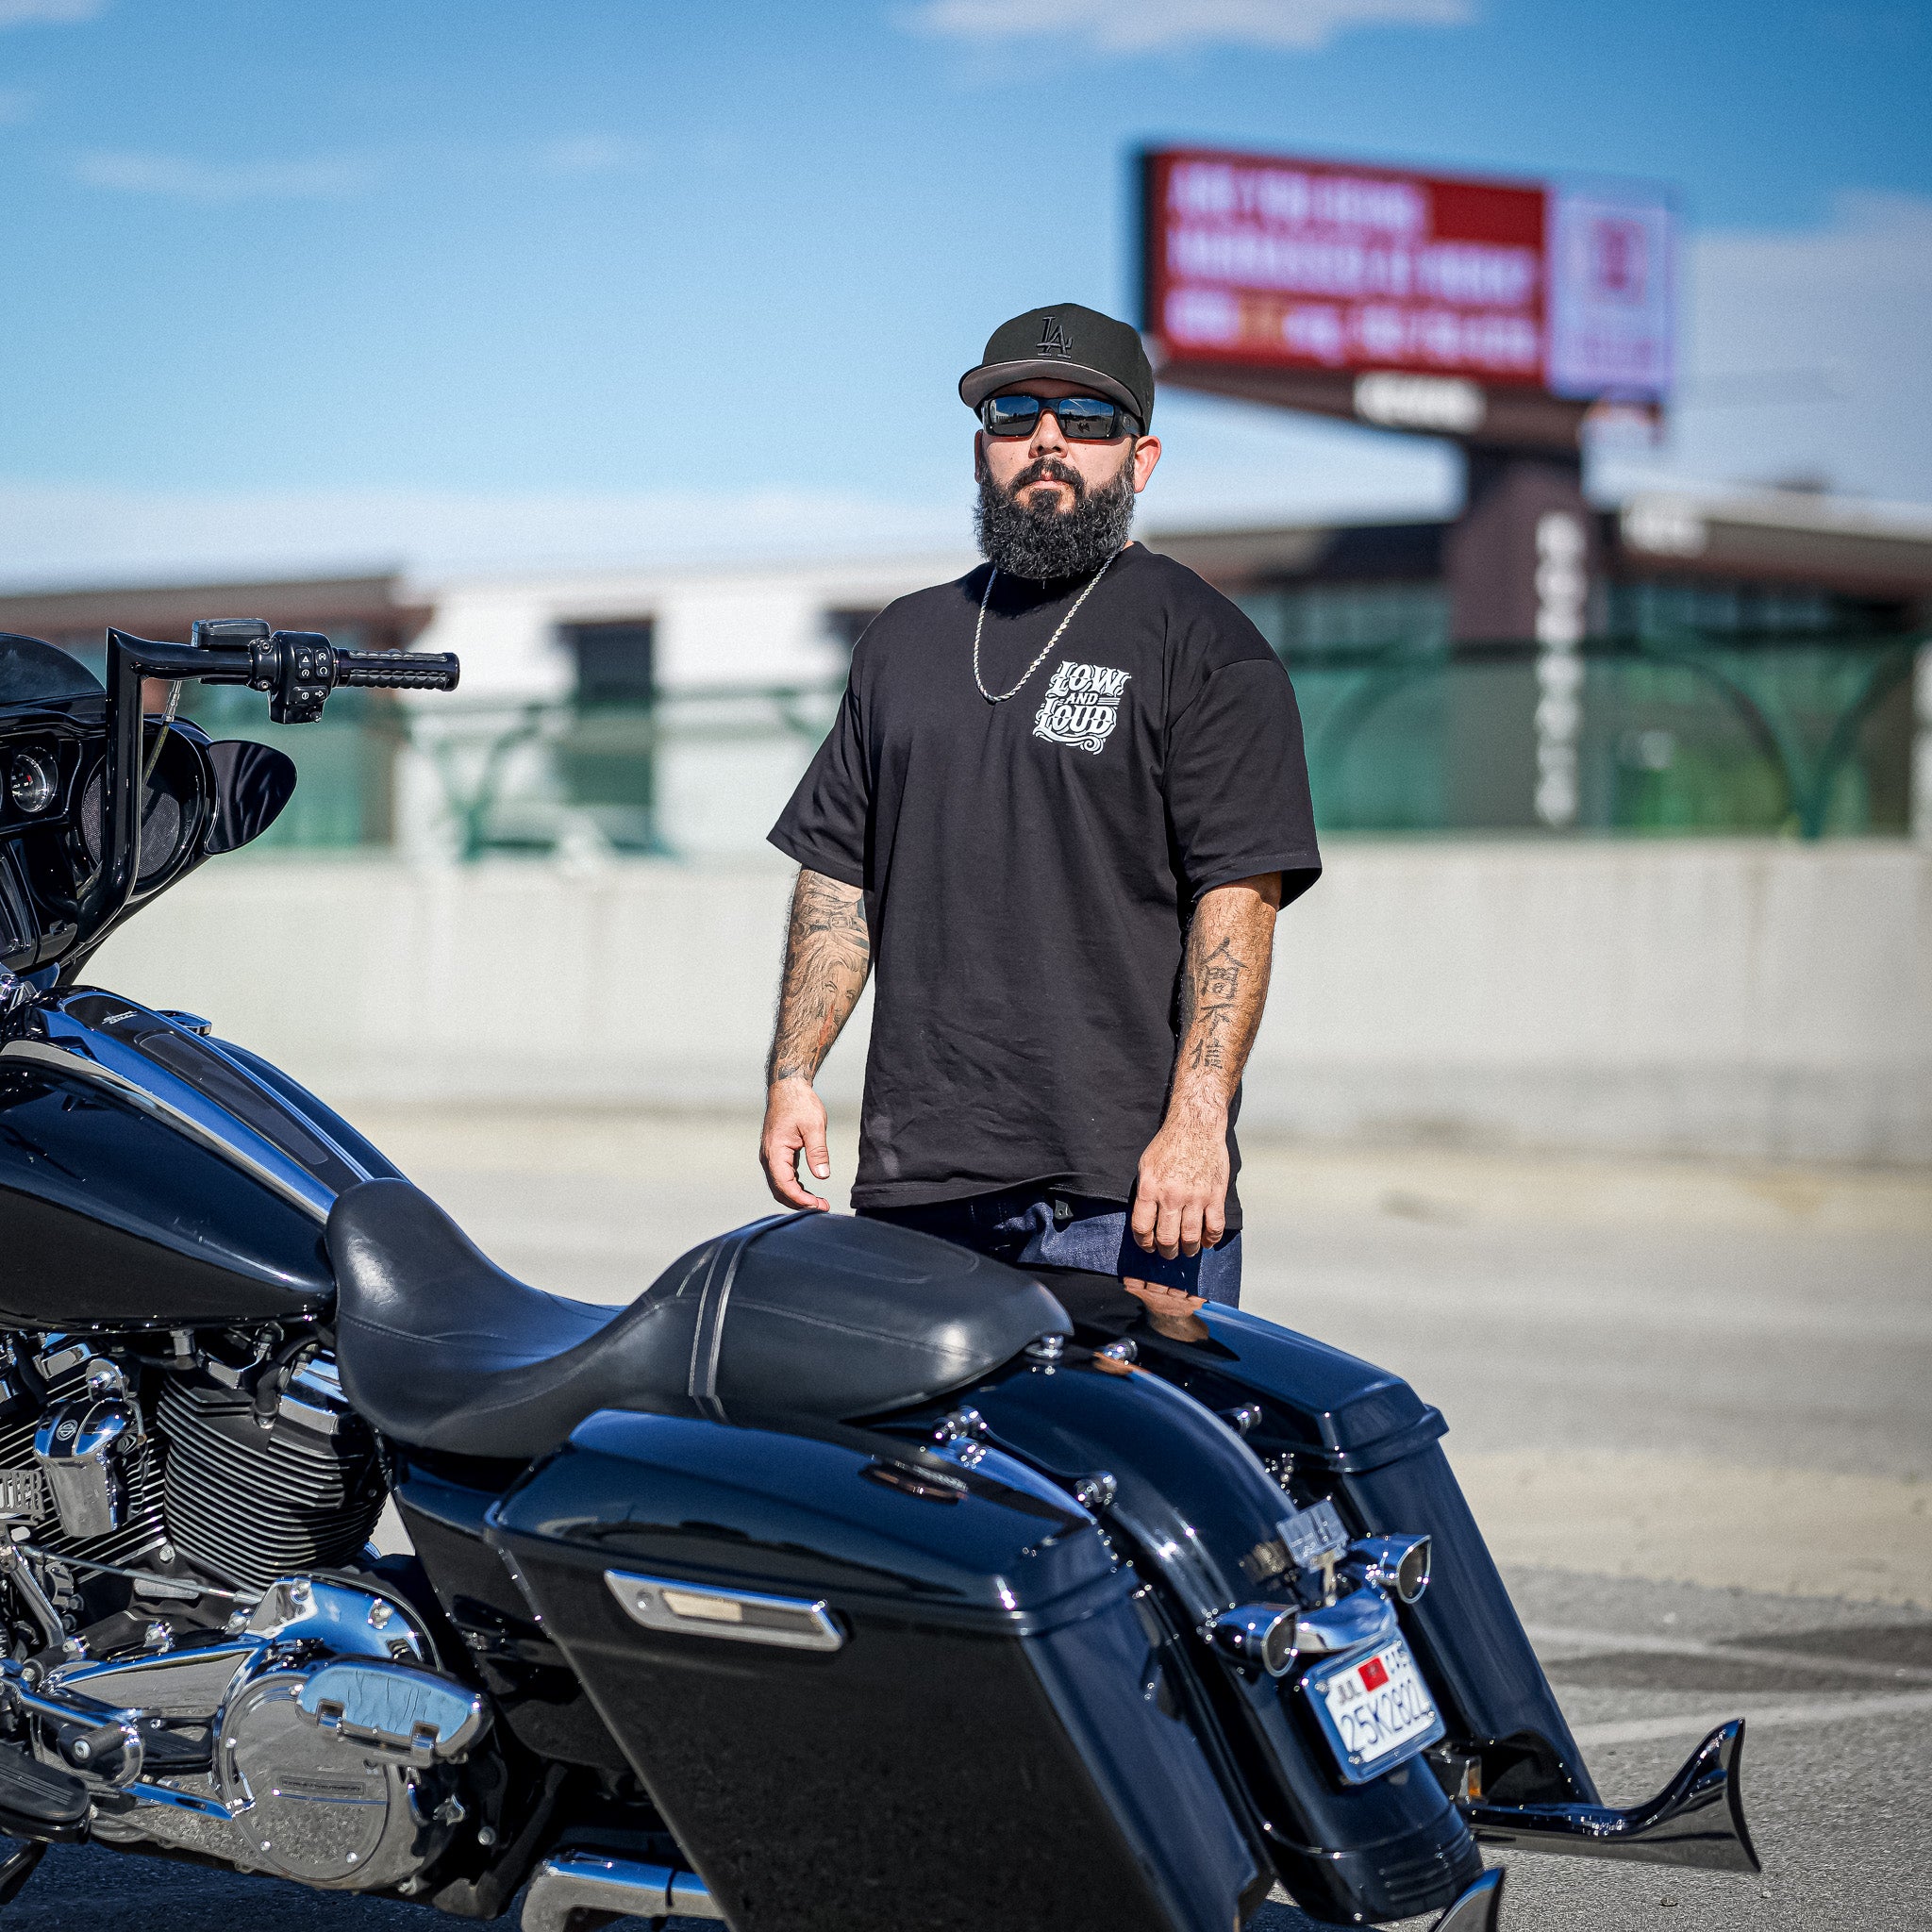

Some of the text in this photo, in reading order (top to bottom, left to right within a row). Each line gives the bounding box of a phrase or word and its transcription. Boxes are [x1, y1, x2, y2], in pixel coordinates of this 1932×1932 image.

[1036, 315, 1074, 359] LA
[1045, 660, 1132, 698] LOW
[1064, 692, 1099, 706] AND
[1033, 697, 1117, 753] LOUD
